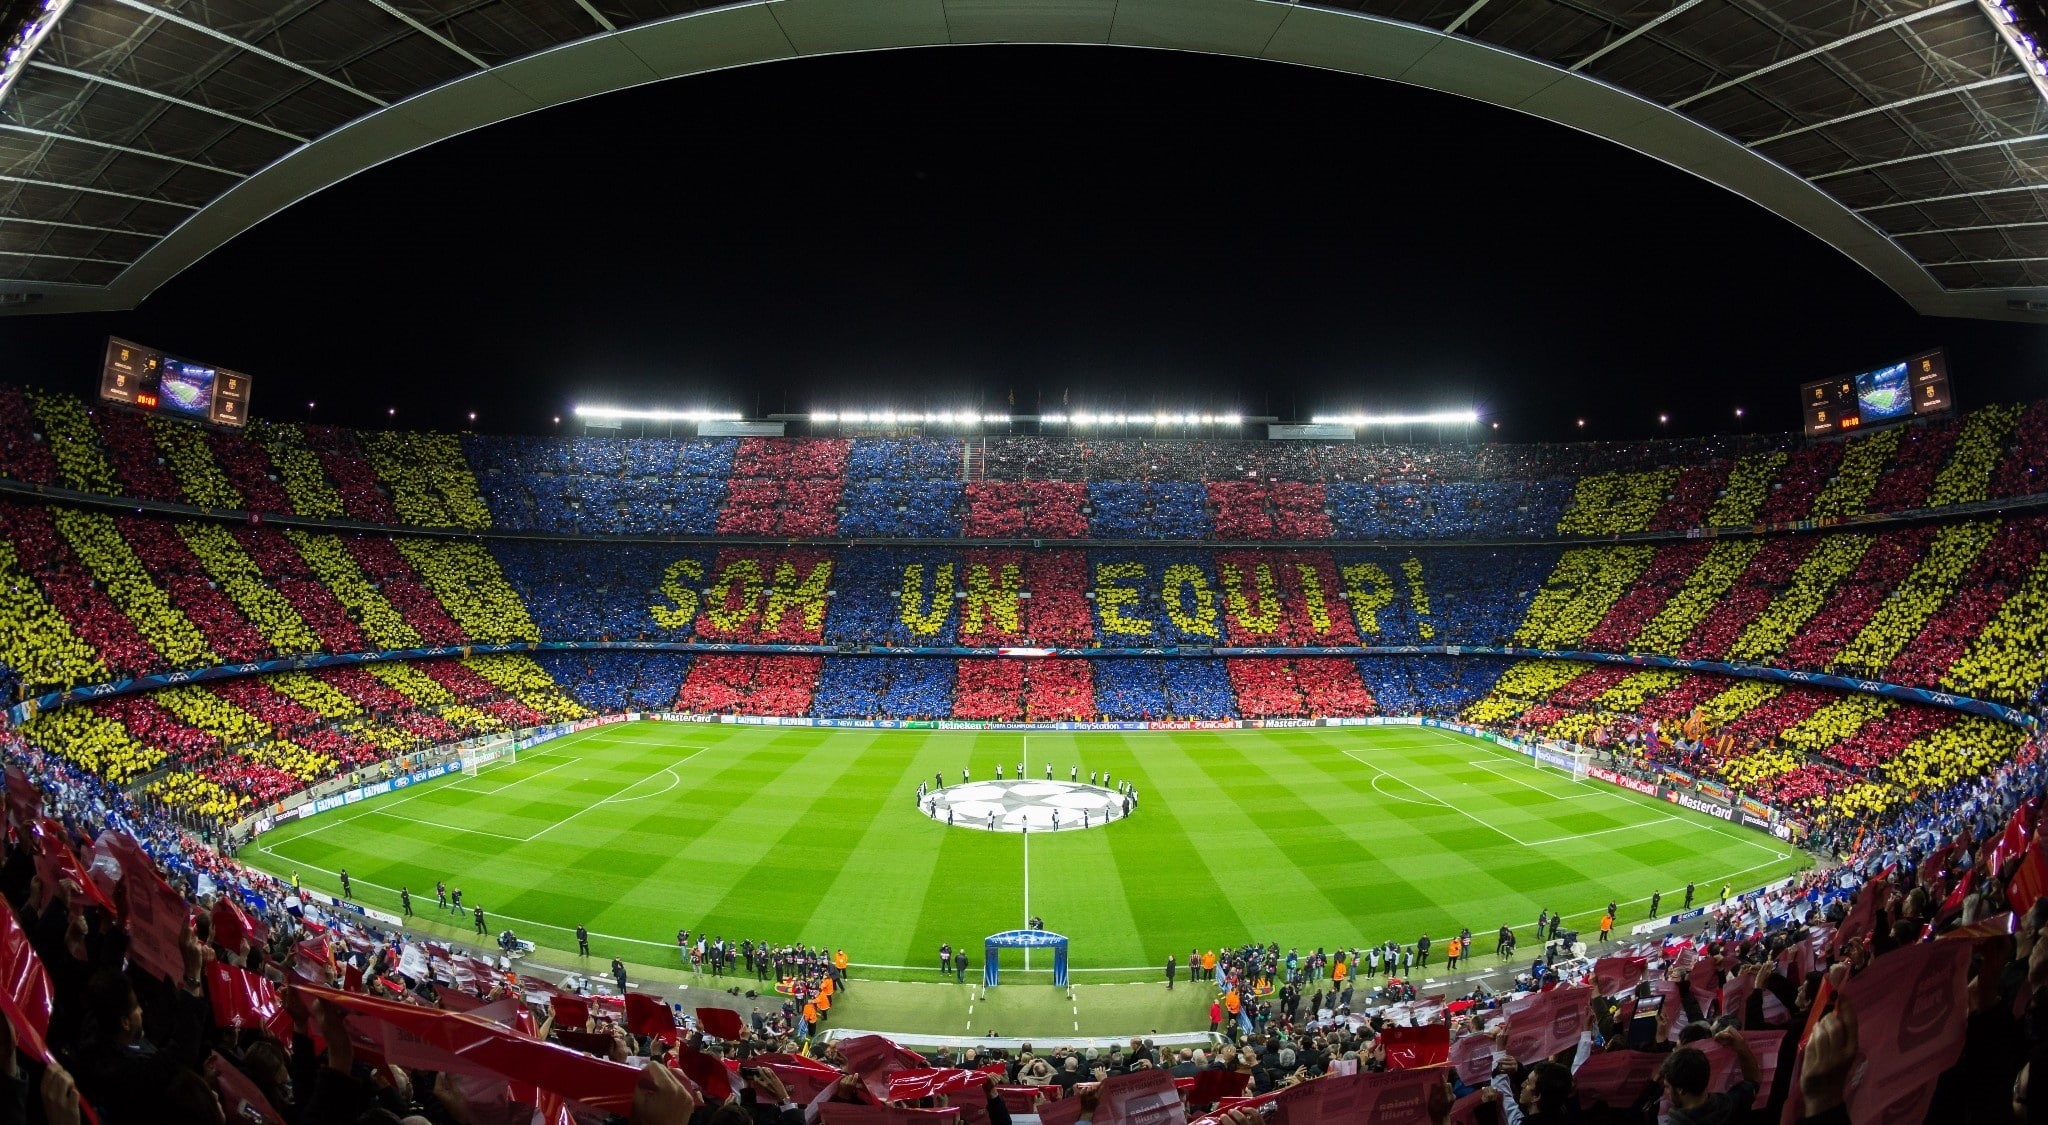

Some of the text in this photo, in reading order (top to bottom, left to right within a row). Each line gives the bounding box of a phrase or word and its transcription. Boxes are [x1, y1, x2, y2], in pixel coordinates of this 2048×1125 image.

[649, 557, 1434, 640] SOM UN EQUIP!
[662, 713, 711, 722] MasterCard
[938, 720, 982, 730] Heineken
[1074, 722, 1119, 730] PlayStation
[1158, 720, 1190, 729] UniCredit
[1202, 720, 1235, 729] UniCredit
[1266, 719, 1316, 728] MasterCard
[464, 751, 495, 768] Heneken
[413, 767, 446, 782] NEW KUGA
[1625, 775, 1654, 797] UniCredit
[1678, 794, 1733, 821] MasterCard
